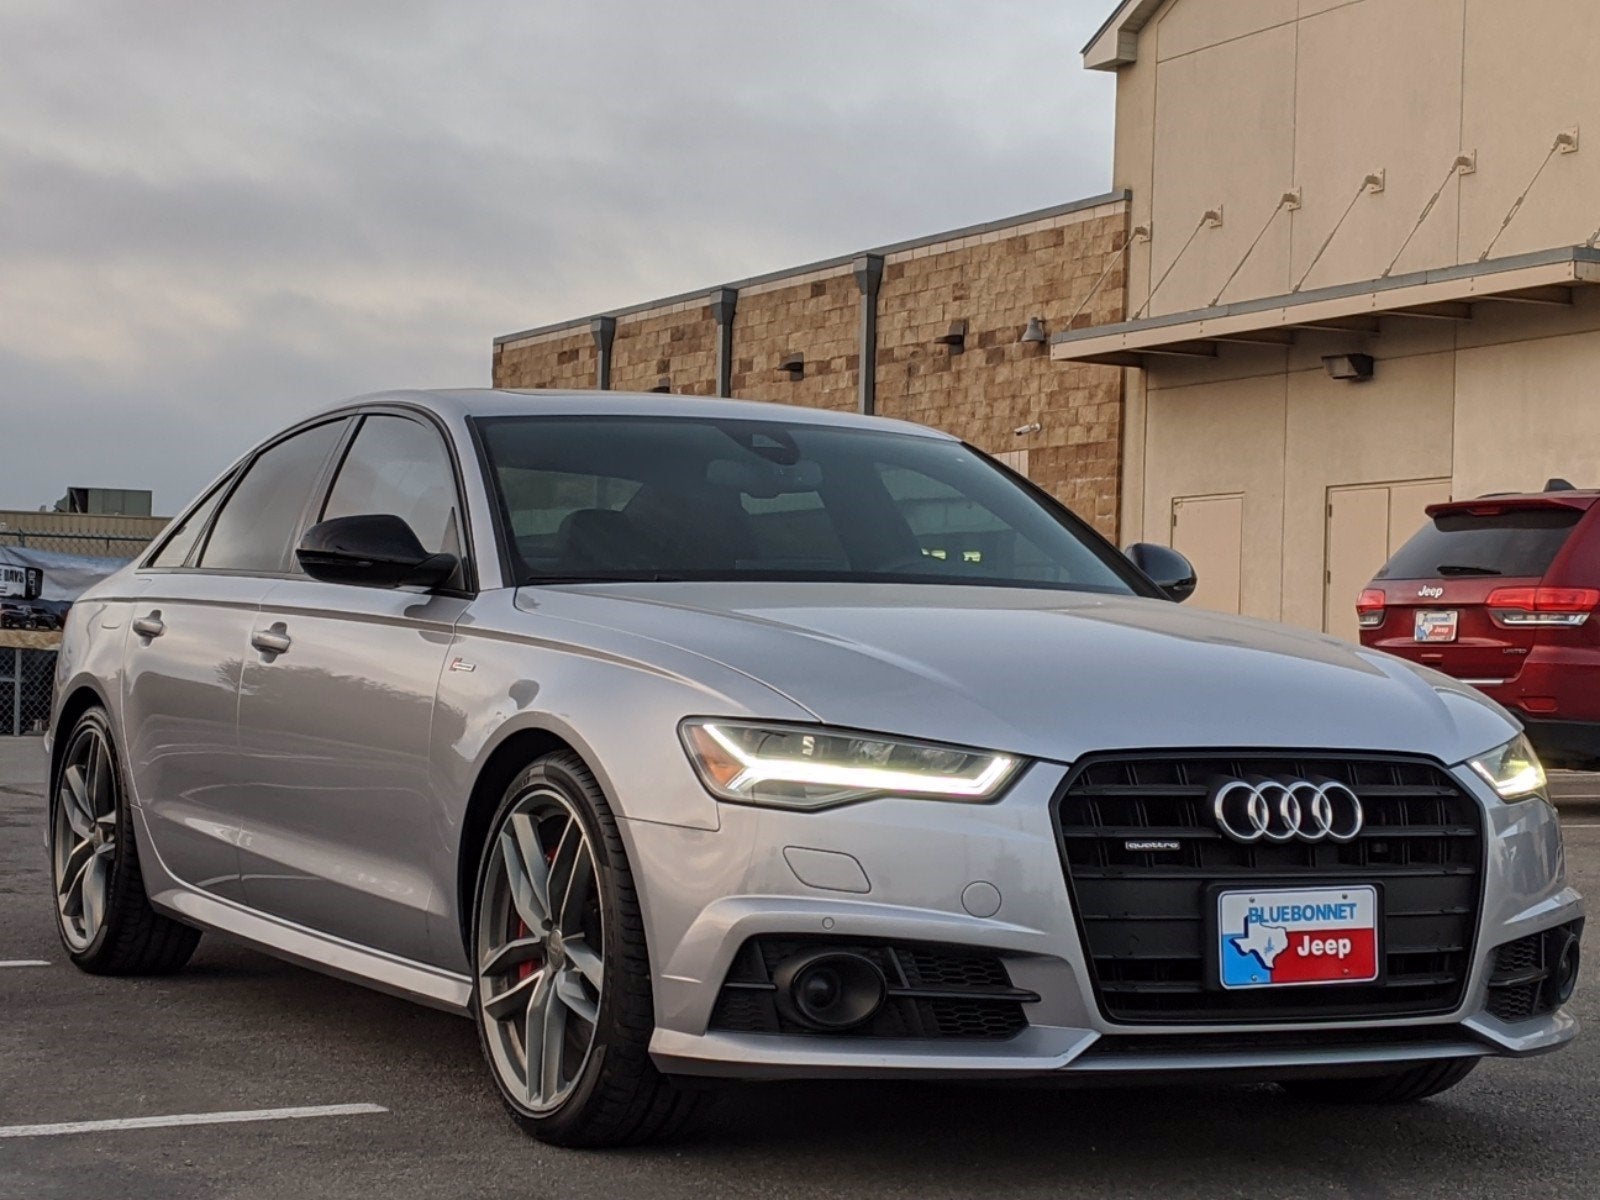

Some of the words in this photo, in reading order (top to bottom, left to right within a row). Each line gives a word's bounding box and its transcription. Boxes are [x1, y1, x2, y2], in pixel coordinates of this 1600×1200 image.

[4, 568, 25, 584] DAYS
[1418, 585, 1443, 598] Jeep
[1248, 903, 1357, 923] BLUEBONNET
[1297, 935, 1351, 958] Jeep
